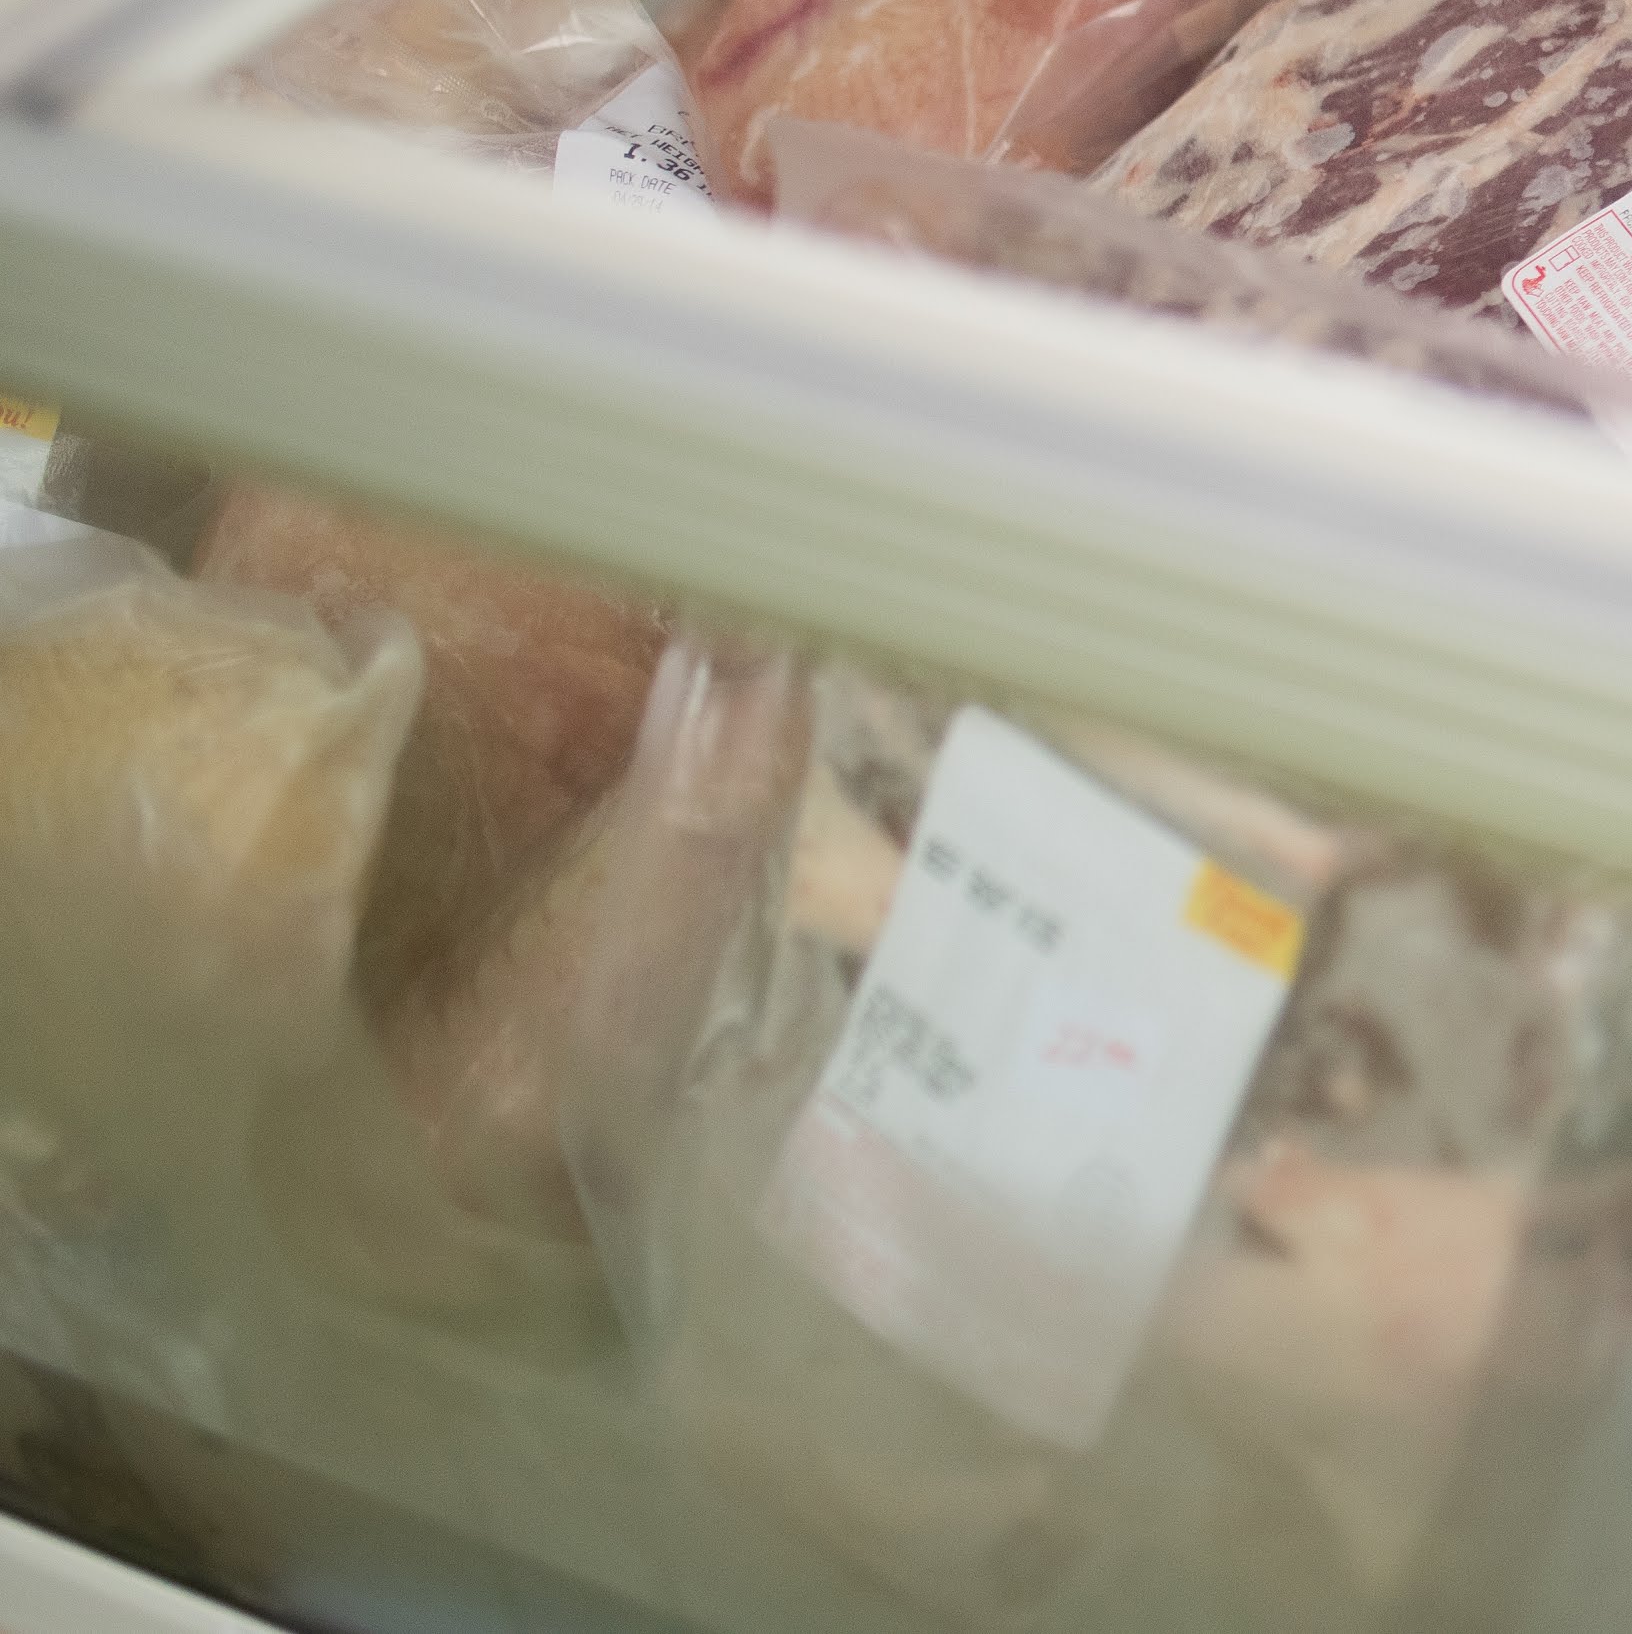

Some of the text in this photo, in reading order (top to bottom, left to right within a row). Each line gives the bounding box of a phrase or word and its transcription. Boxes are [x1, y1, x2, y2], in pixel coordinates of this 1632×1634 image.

[623, 142, 695, 182] 1.36
[610, 168, 636, 185] PACK
[641, 175, 676, 195] DATE
